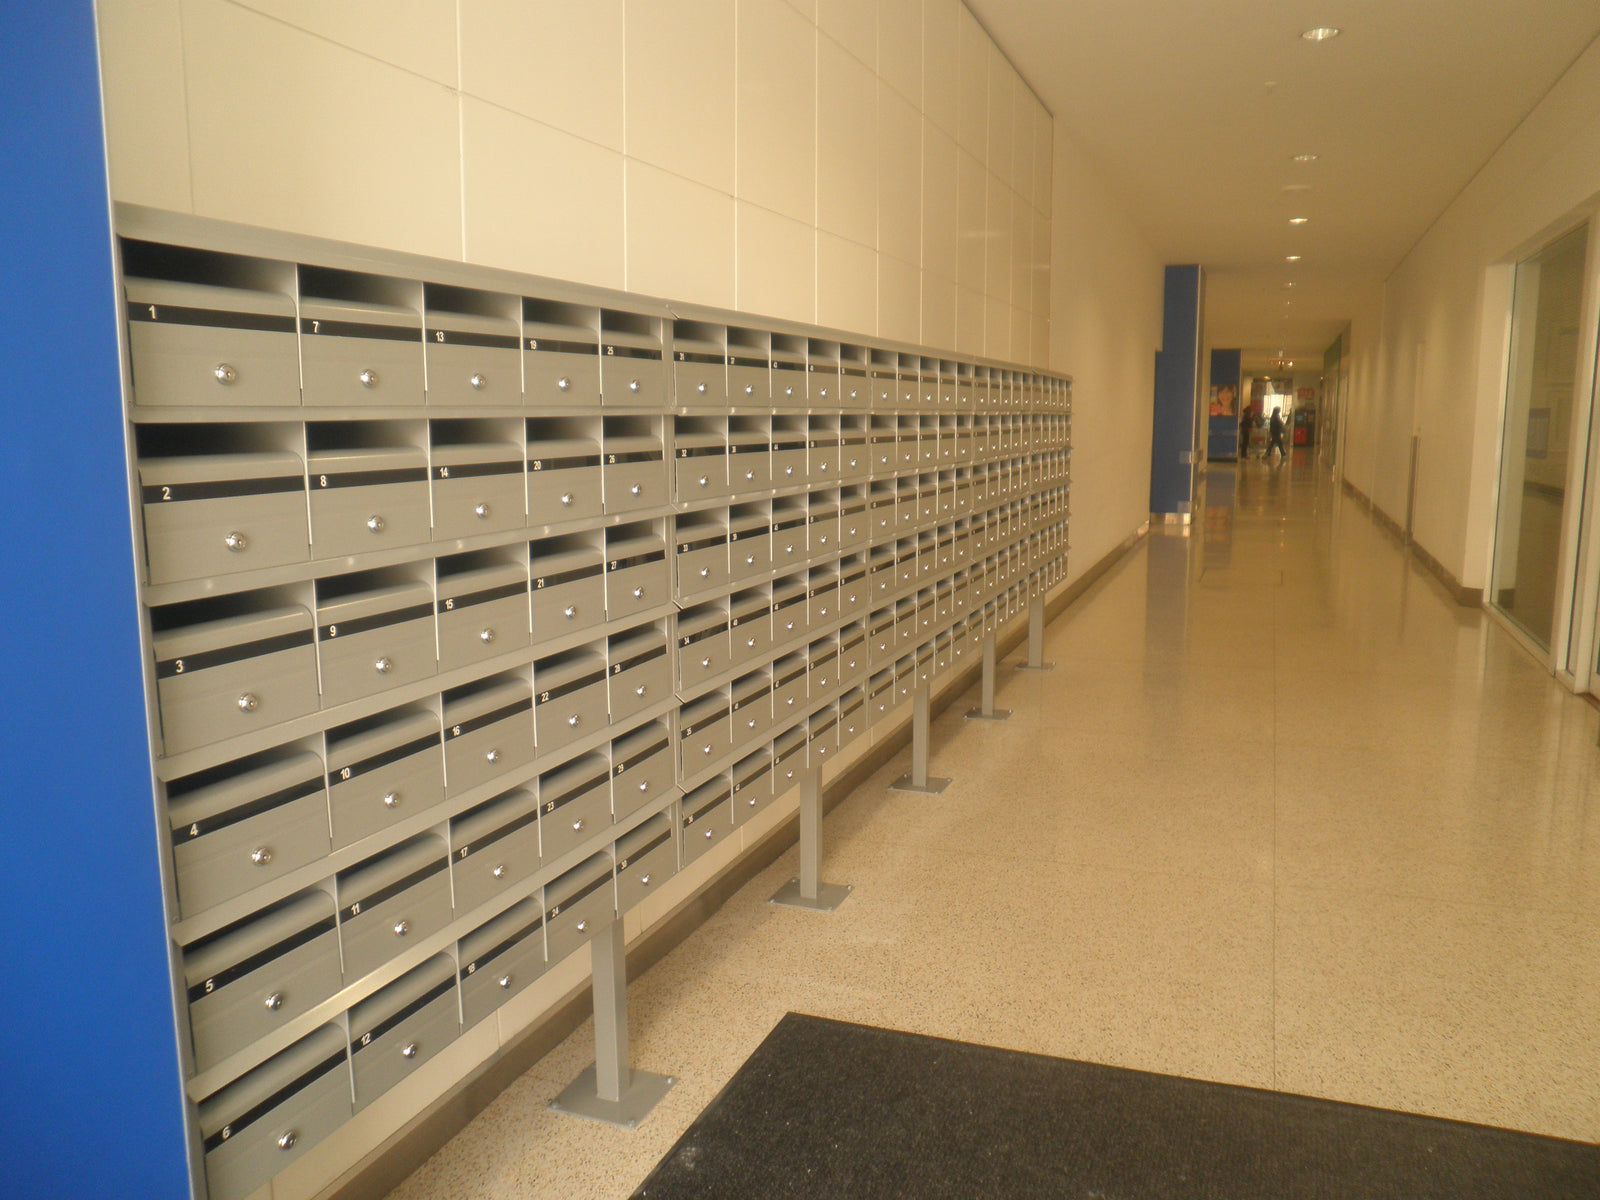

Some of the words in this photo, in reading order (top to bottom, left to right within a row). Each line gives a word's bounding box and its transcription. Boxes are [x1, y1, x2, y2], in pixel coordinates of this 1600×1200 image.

[148, 304, 157, 320] 1
[312, 320, 321, 334] 7
[435, 331, 445, 343] 13
[529, 339, 538, 350] 19
[439, 466, 450, 478] 14
[533, 460, 542, 471] 20
[320, 474, 328, 488] 8
[162, 486, 173, 501] 2
[537, 577, 545, 589] 21
[445, 598, 454, 610] 15
[329, 624, 338, 637] 9
[175, 659, 185, 673] 3
[541, 691, 549, 702] 22
[452, 725, 461, 737] 16
[340, 767, 352, 780] 10
[547, 801, 555, 812] 23
[189, 823, 199, 836] 4
[460, 846, 469, 858] 17
[351, 902, 360, 915] 11
[205, 978, 215, 993] 5
[361, 1033, 371, 1046] 12
[222, 1125, 231, 1139] 6
